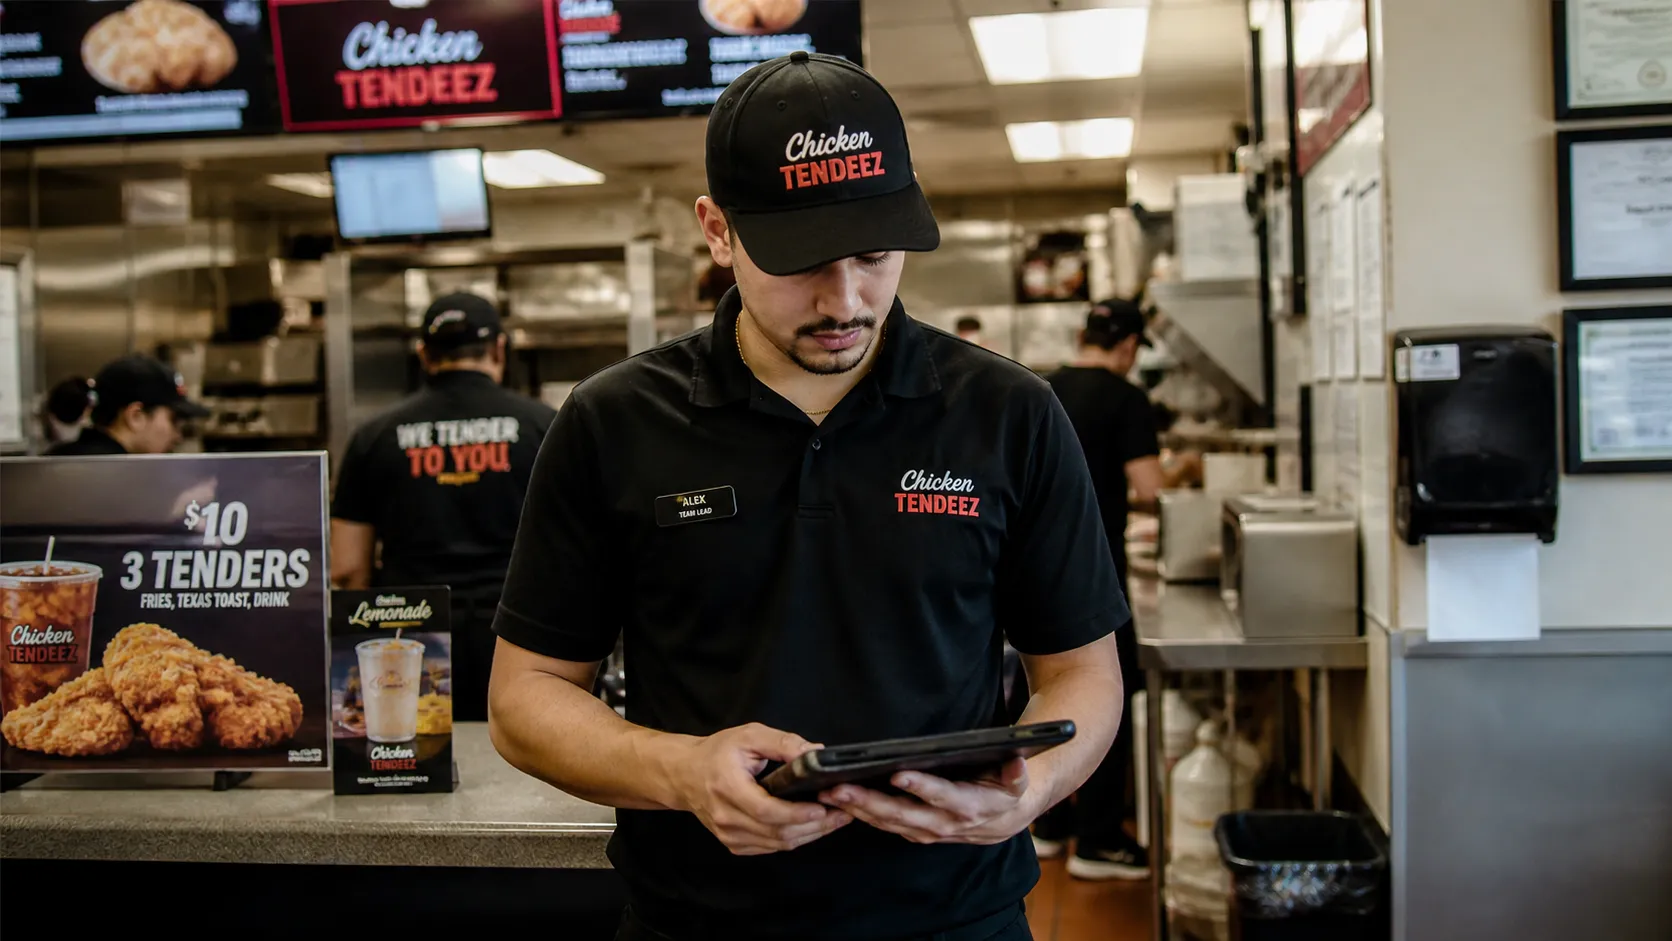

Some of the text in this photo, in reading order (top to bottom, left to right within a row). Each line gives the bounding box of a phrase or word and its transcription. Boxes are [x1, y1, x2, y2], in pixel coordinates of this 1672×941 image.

[342, 18, 484, 71] Chicken
[335, 62, 498, 109] TENDEEZ
[785, 125, 873, 162] Chicken
[779, 151, 886, 190] TENDEEZ
[397, 422, 433, 449] WE
[406, 445, 445, 477] TO
[900, 469, 975, 493] Chicken
[678, 507, 712, 518] TEAM LEAD
[682, 495, 706, 506] ALEX
[894, 493, 980, 517] TENDEEZ
[184, 500, 249, 546] $10
[120, 548, 311, 590] 3 TENDERS
[140, 591, 290, 610] FRIES, TEXAS TOAST, DRINK
[348, 599, 433, 628] Lemonade
[10, 625, 74, 645] Chicken
[8, 644, 78, 664] TENDEEZ
